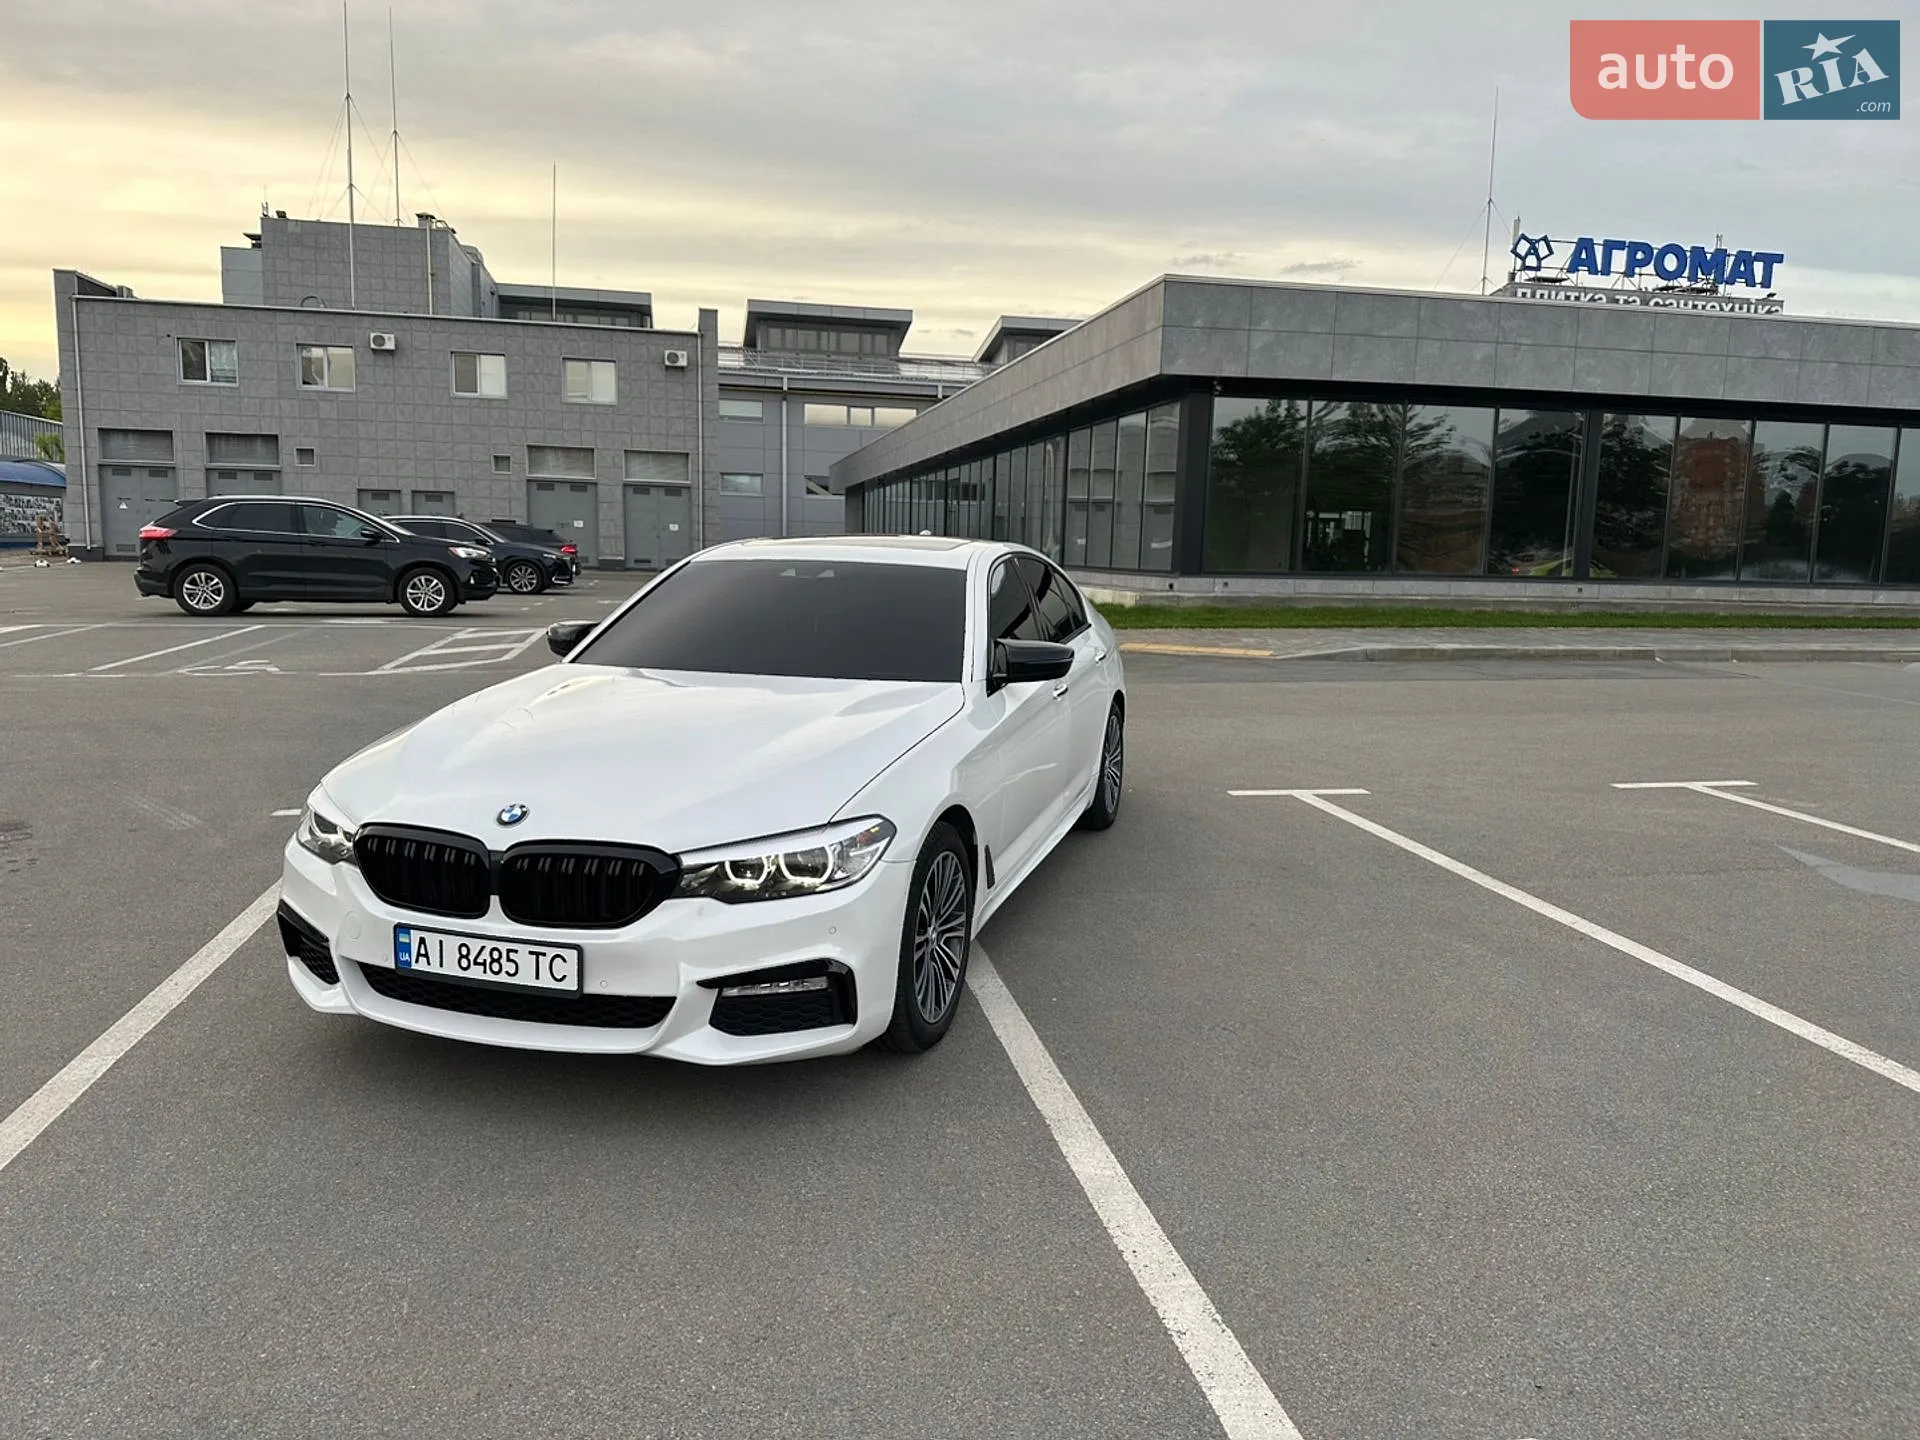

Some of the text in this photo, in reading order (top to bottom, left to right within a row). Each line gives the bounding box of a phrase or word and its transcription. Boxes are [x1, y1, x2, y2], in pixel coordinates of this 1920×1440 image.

[1567, 237, 1784, 289] АГРОМАТ
[399, 951, 411, 962] UA
[415, 936, 567, 983] AI 8485 TC
